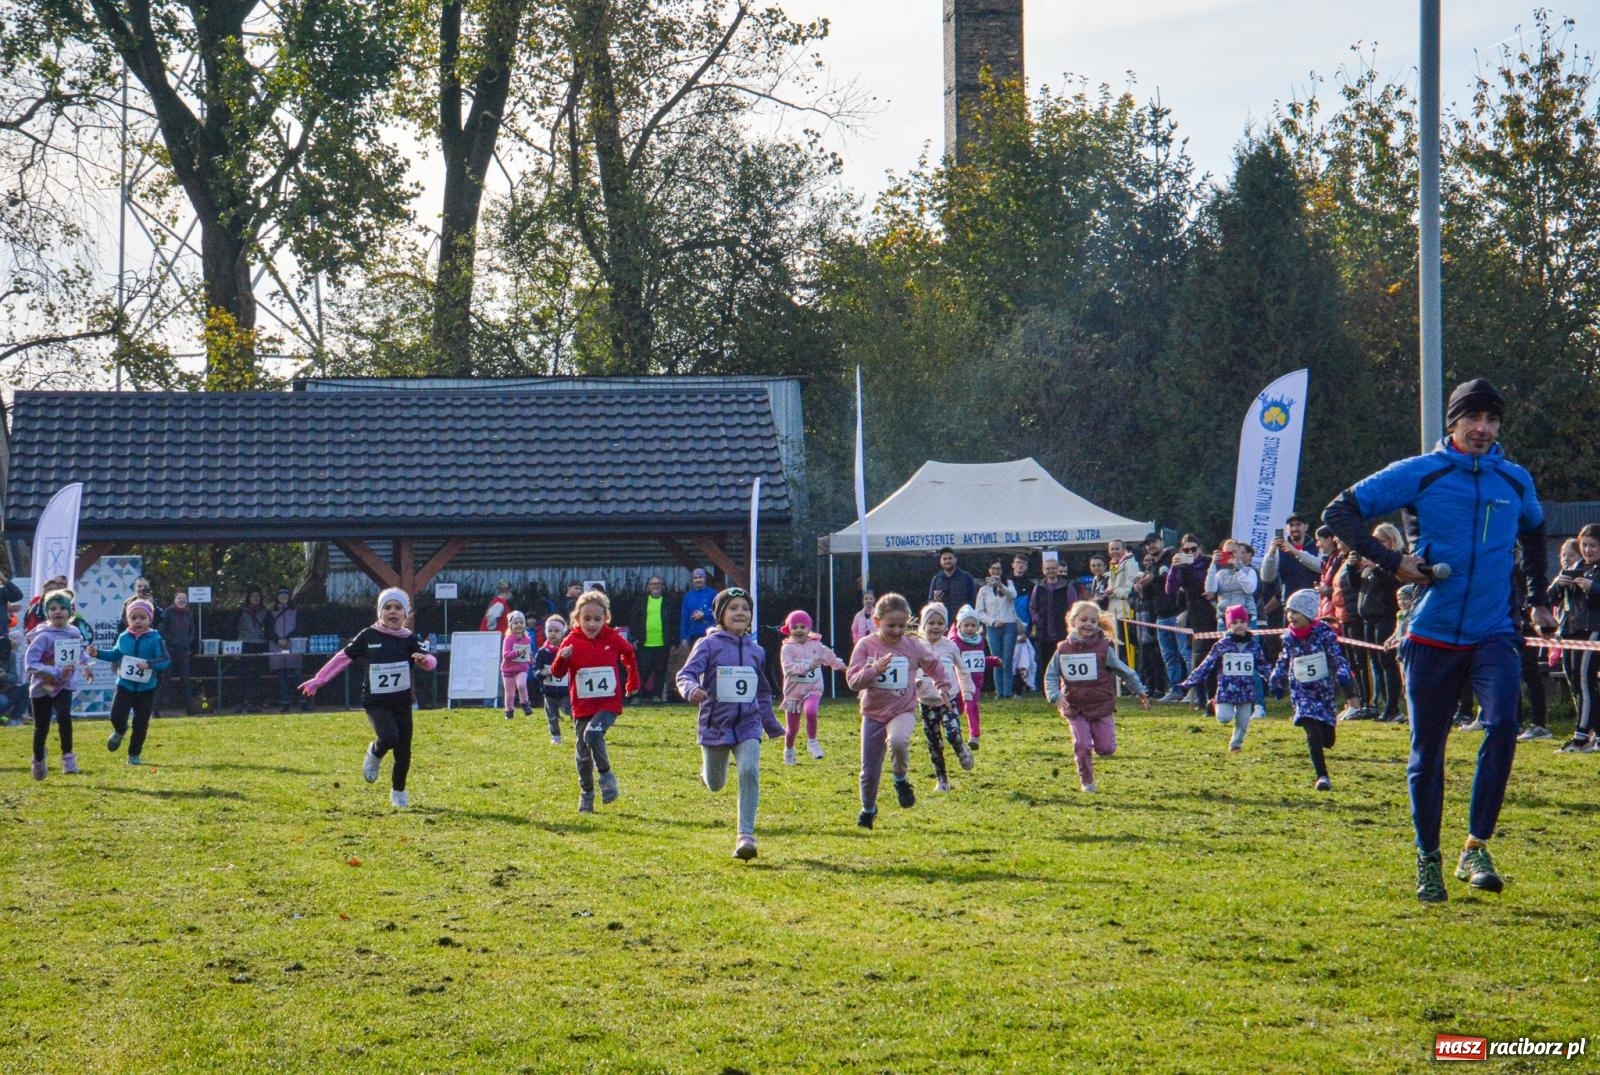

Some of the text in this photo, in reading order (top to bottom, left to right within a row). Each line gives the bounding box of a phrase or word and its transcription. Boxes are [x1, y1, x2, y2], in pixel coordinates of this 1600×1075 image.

[1258, 436, 1280, 486] STOWARZYSZENIE
[1255, 486, 1274, 514] AKTYWNI
[1253, 514, 1270, 526] DLA
[885, 529, 1100, 547] STOWARZYSZENIE AKTYWNI DLA LEPSZEGO JUTRA
[60, 649, 75, 661] 31
[965, 658, 984, 669] 122
[1067, 663, 1088, 676] 30
[1225, 661, 1252, 672] 116
[126, 665, 144, 678] 34
[1307, 665, 1316, 677] 5
[378, 673, 401, 687] 27
[585, 677, 608, 692] 14
[735, 680, 748, 695] 9
